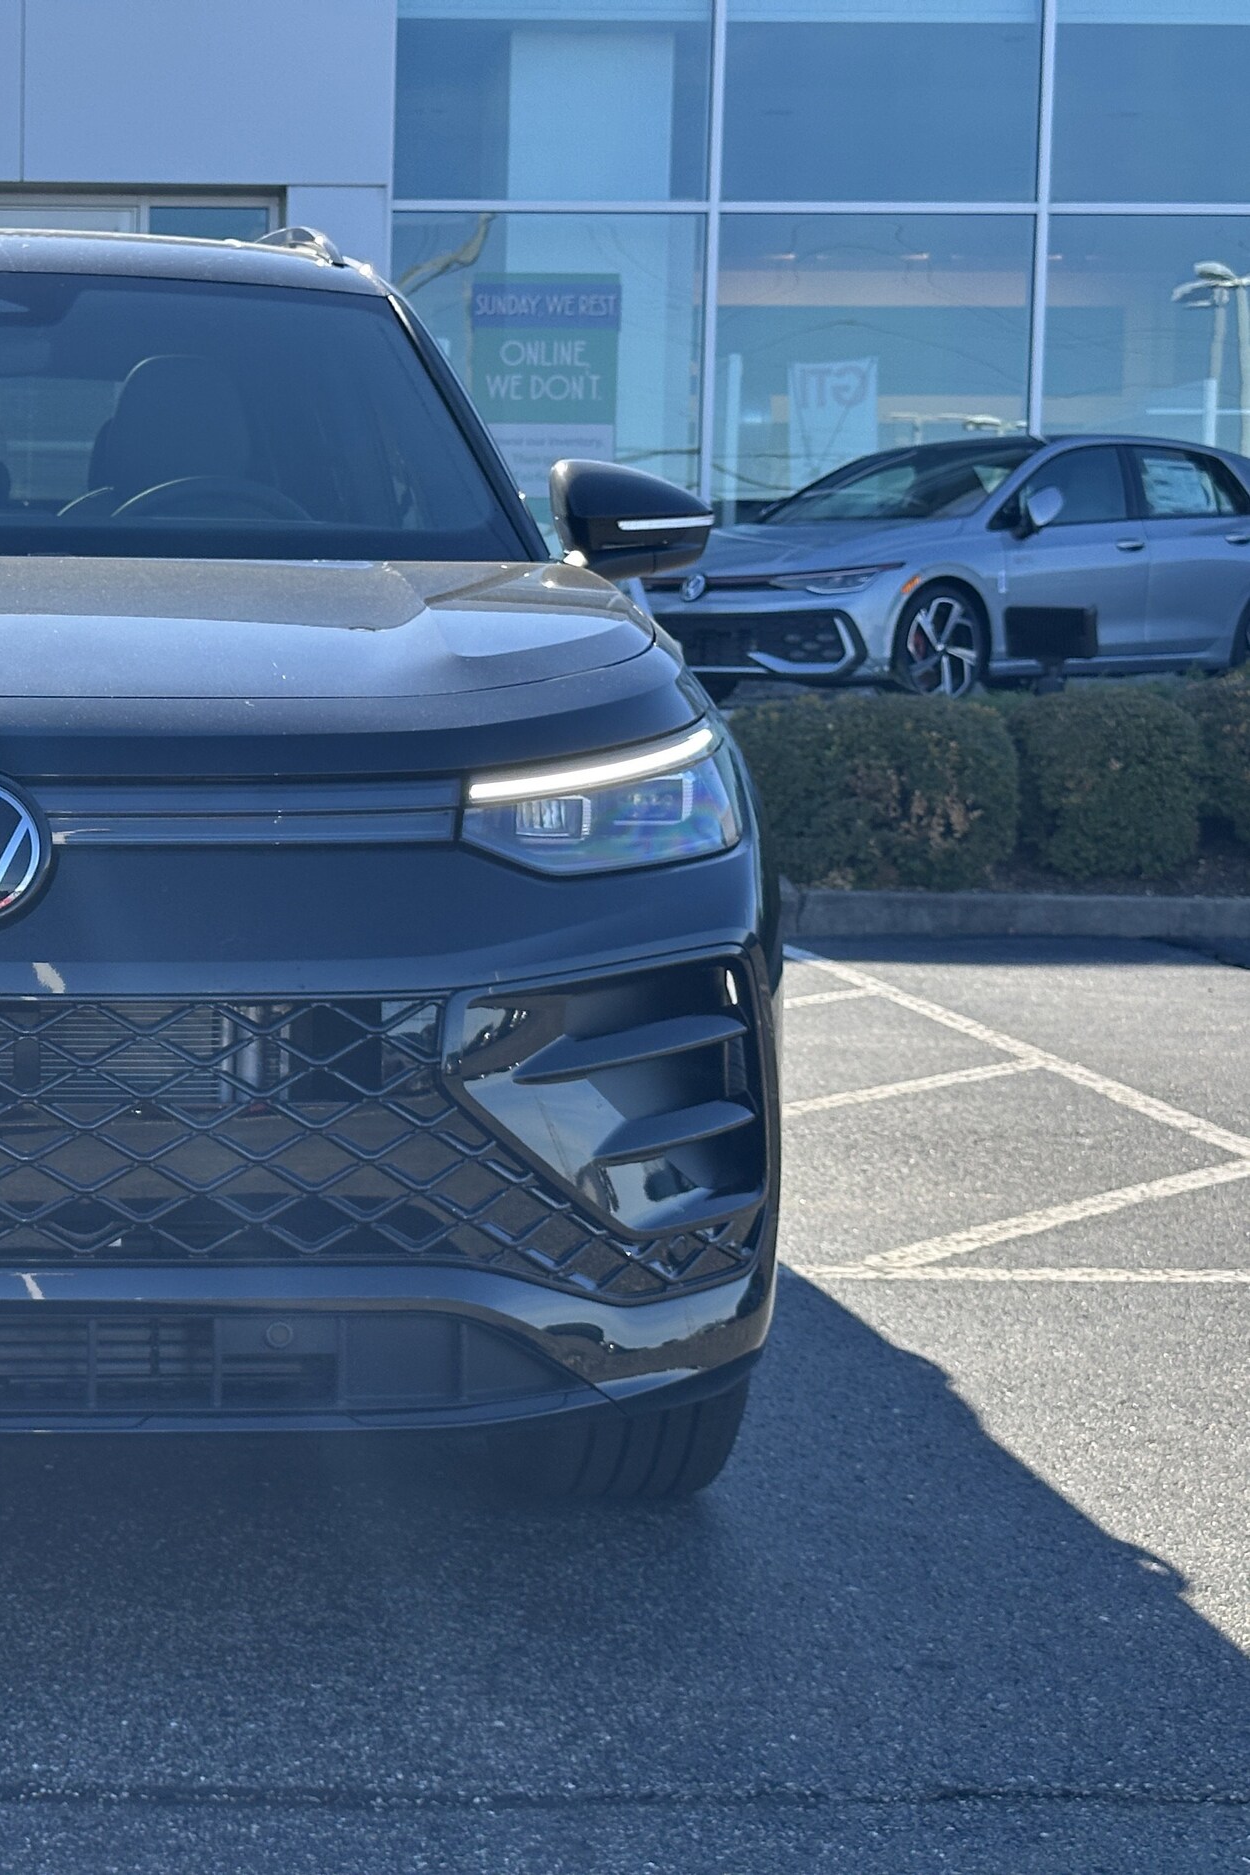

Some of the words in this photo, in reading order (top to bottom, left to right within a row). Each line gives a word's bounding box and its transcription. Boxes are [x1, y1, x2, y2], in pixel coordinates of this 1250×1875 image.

[476, 294, 542, 318] SUNDAY,
[548, 294, 575, 317] WE
[580, 295, 617, 316] REST
[488, 375, 523, 400] WE
